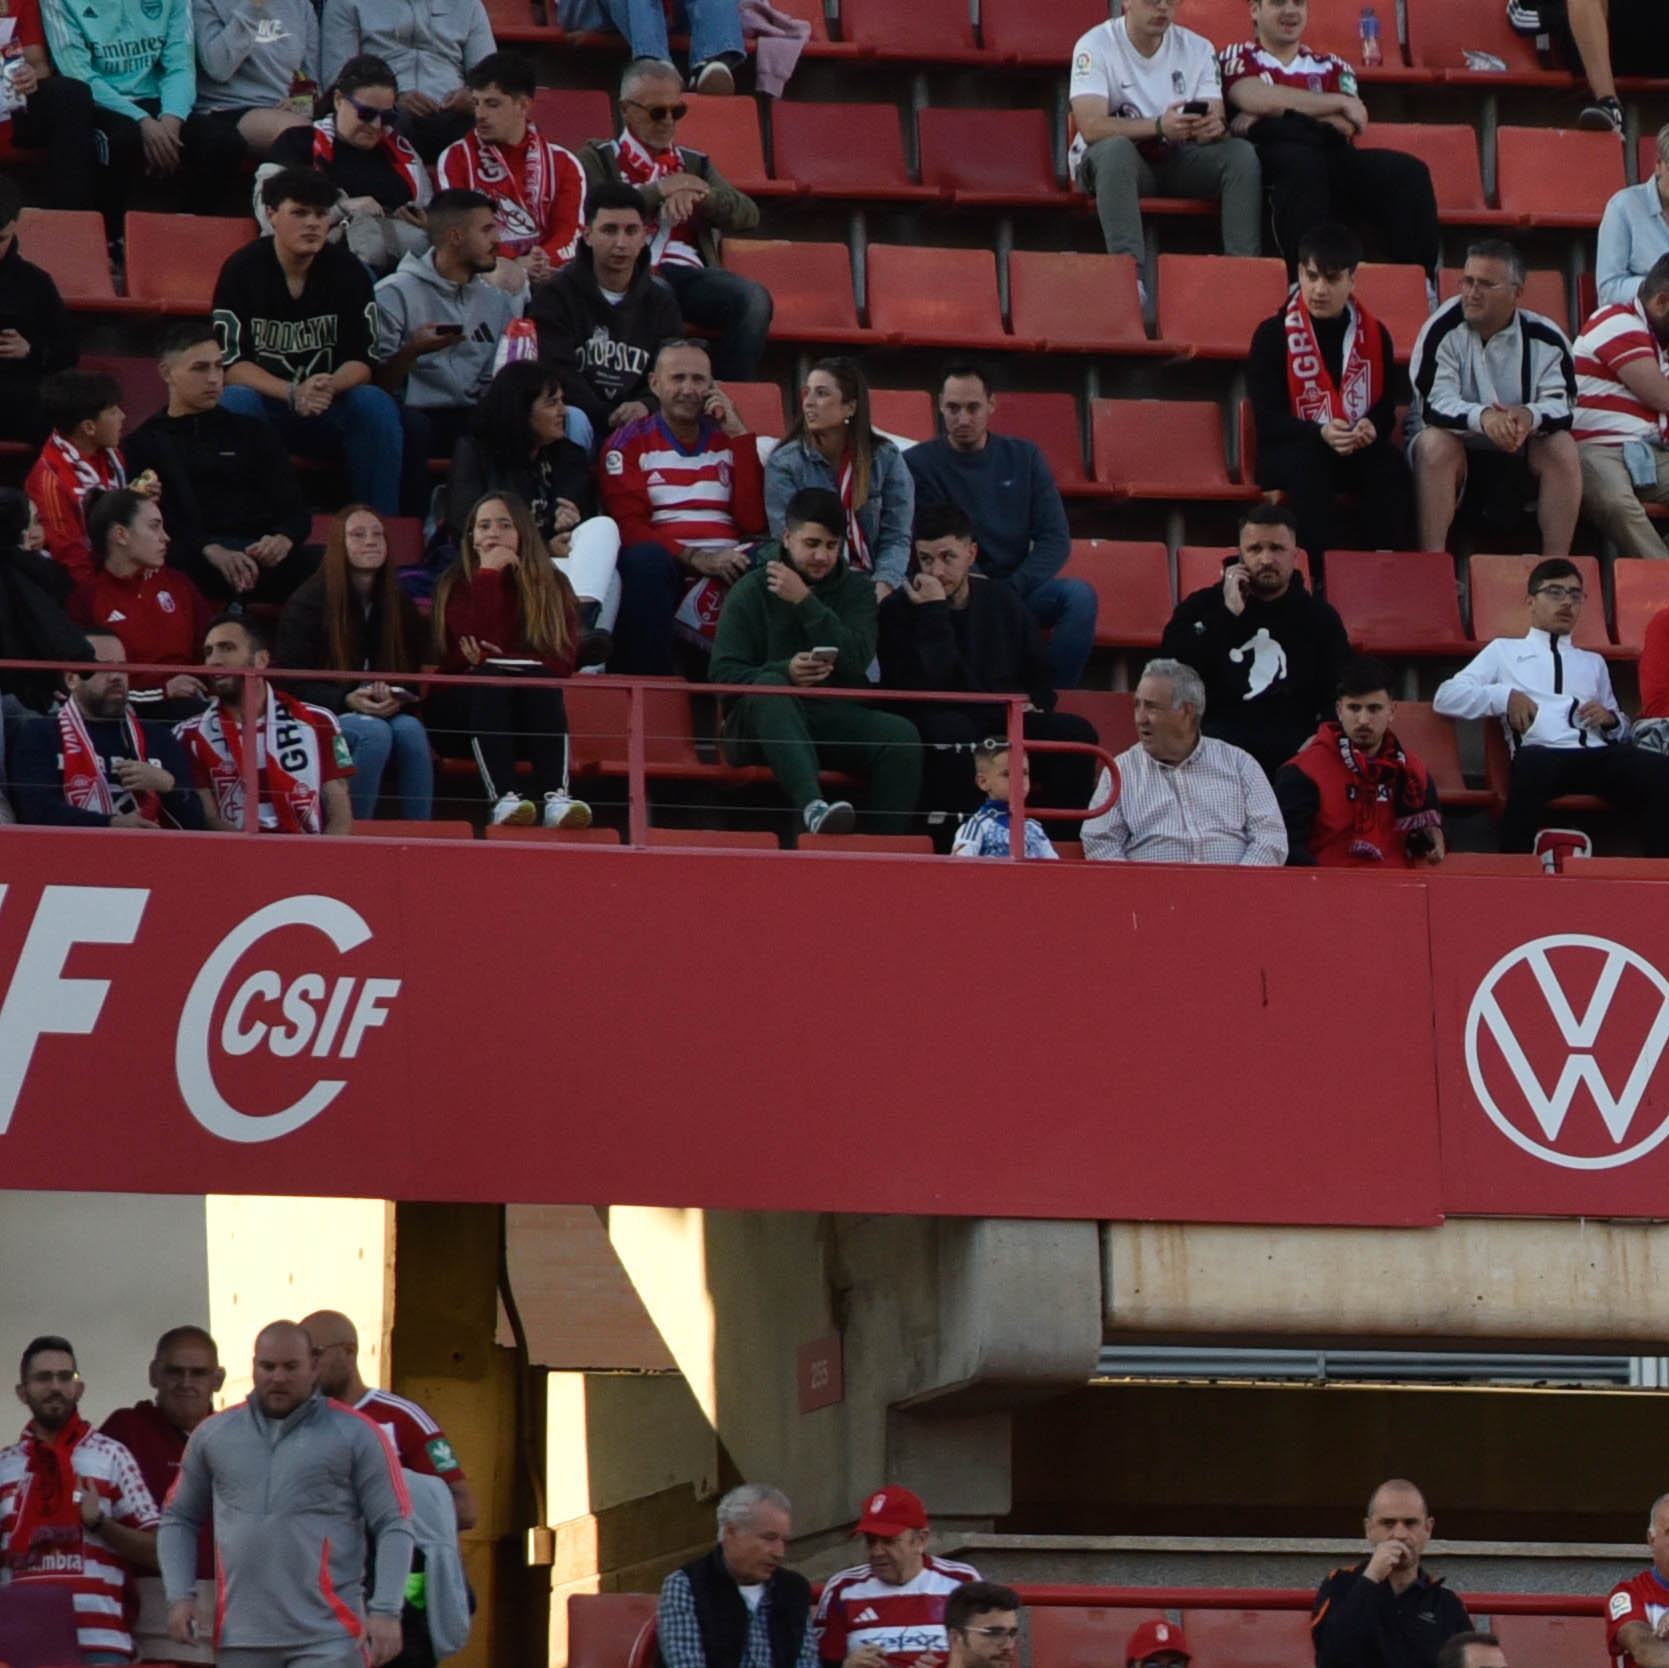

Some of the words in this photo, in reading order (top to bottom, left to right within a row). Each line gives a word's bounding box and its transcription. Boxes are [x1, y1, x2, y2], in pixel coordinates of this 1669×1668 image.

[88, 35, 167, 59] Emirates
[251, 314, 338, 353] BROOKLYN
[221, 969, 402, 1059] CSIF
